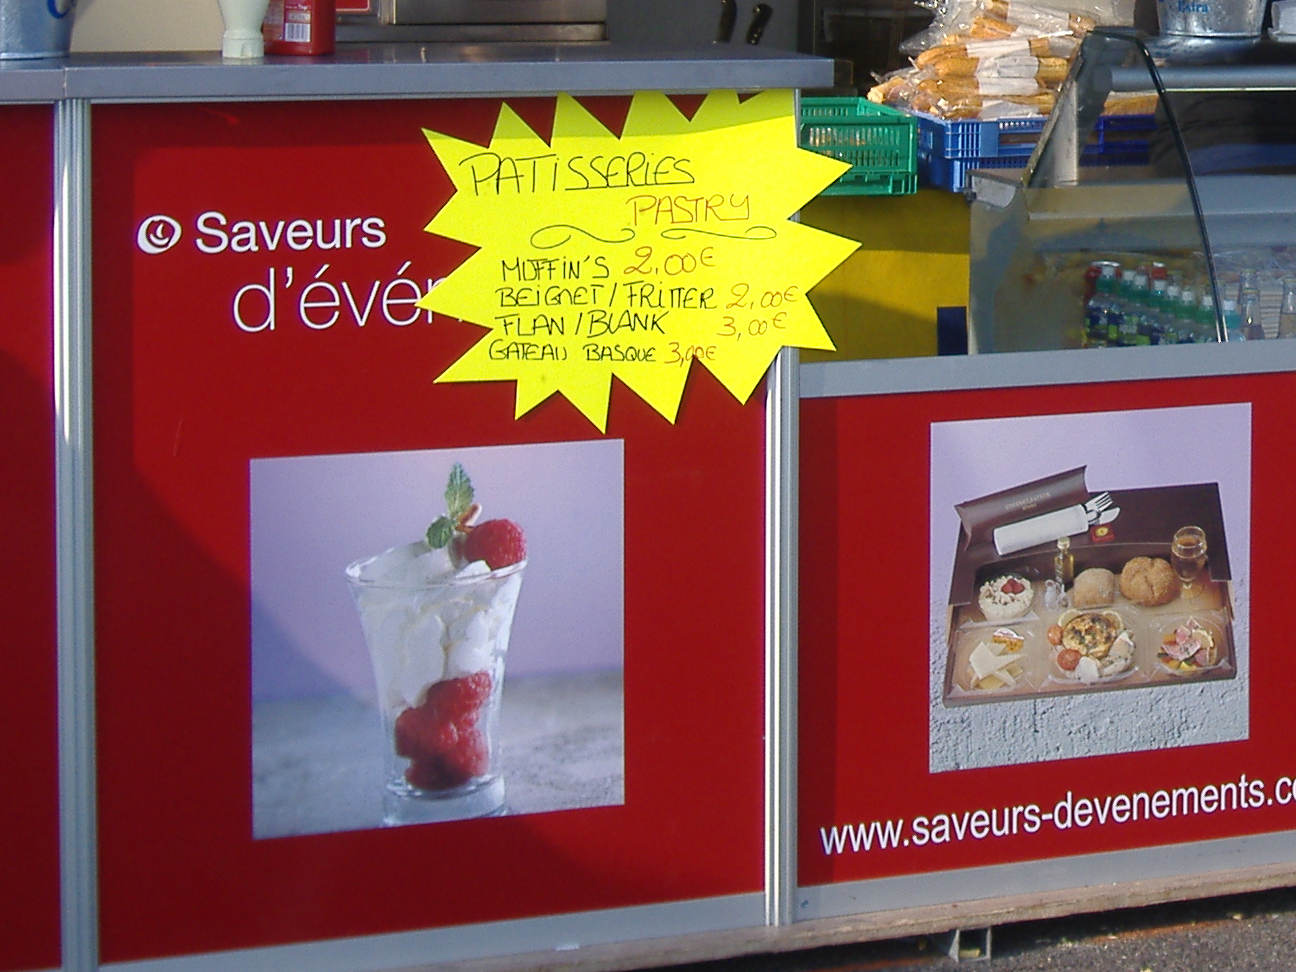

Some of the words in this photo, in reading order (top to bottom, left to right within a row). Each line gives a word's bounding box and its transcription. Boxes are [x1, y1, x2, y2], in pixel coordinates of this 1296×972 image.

[1178, 0, 1209, 13] Extra
[459, 151, 695, 196] PATISSERIES
[626, 193, 750, 226] PASTRY
[195, 211, 388, 254] Saveurs
[582, 342, 657, 363] BASQUE
